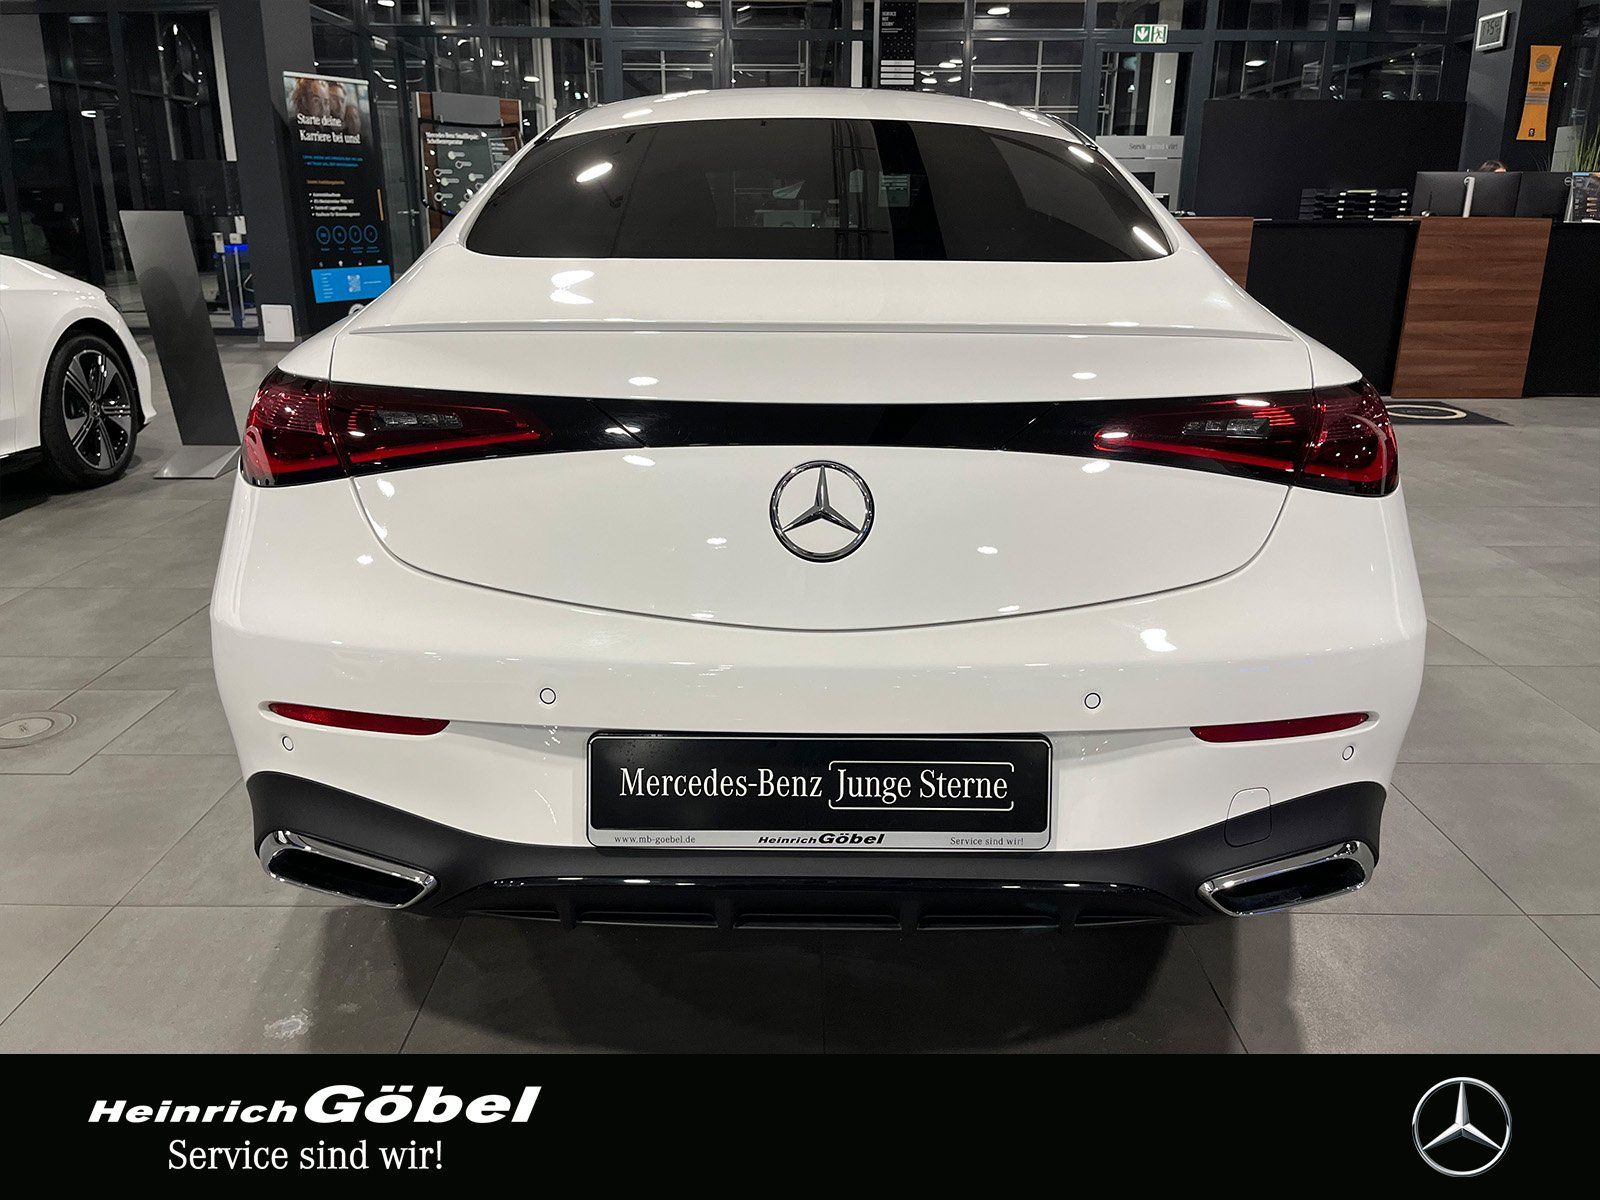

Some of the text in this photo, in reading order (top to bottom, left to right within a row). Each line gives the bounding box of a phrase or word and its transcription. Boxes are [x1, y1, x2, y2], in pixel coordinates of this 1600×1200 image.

[297, 113, 342, 127] Starte deine
[299, 130, 361, 144] Karriere bei uns!
[619, 767, 1008, 804] Mercedes-Benz Junge Sterne
[614, 832, 1024, 845] www.mb-goebel.de Heinrich Göbel Service sind wir!
